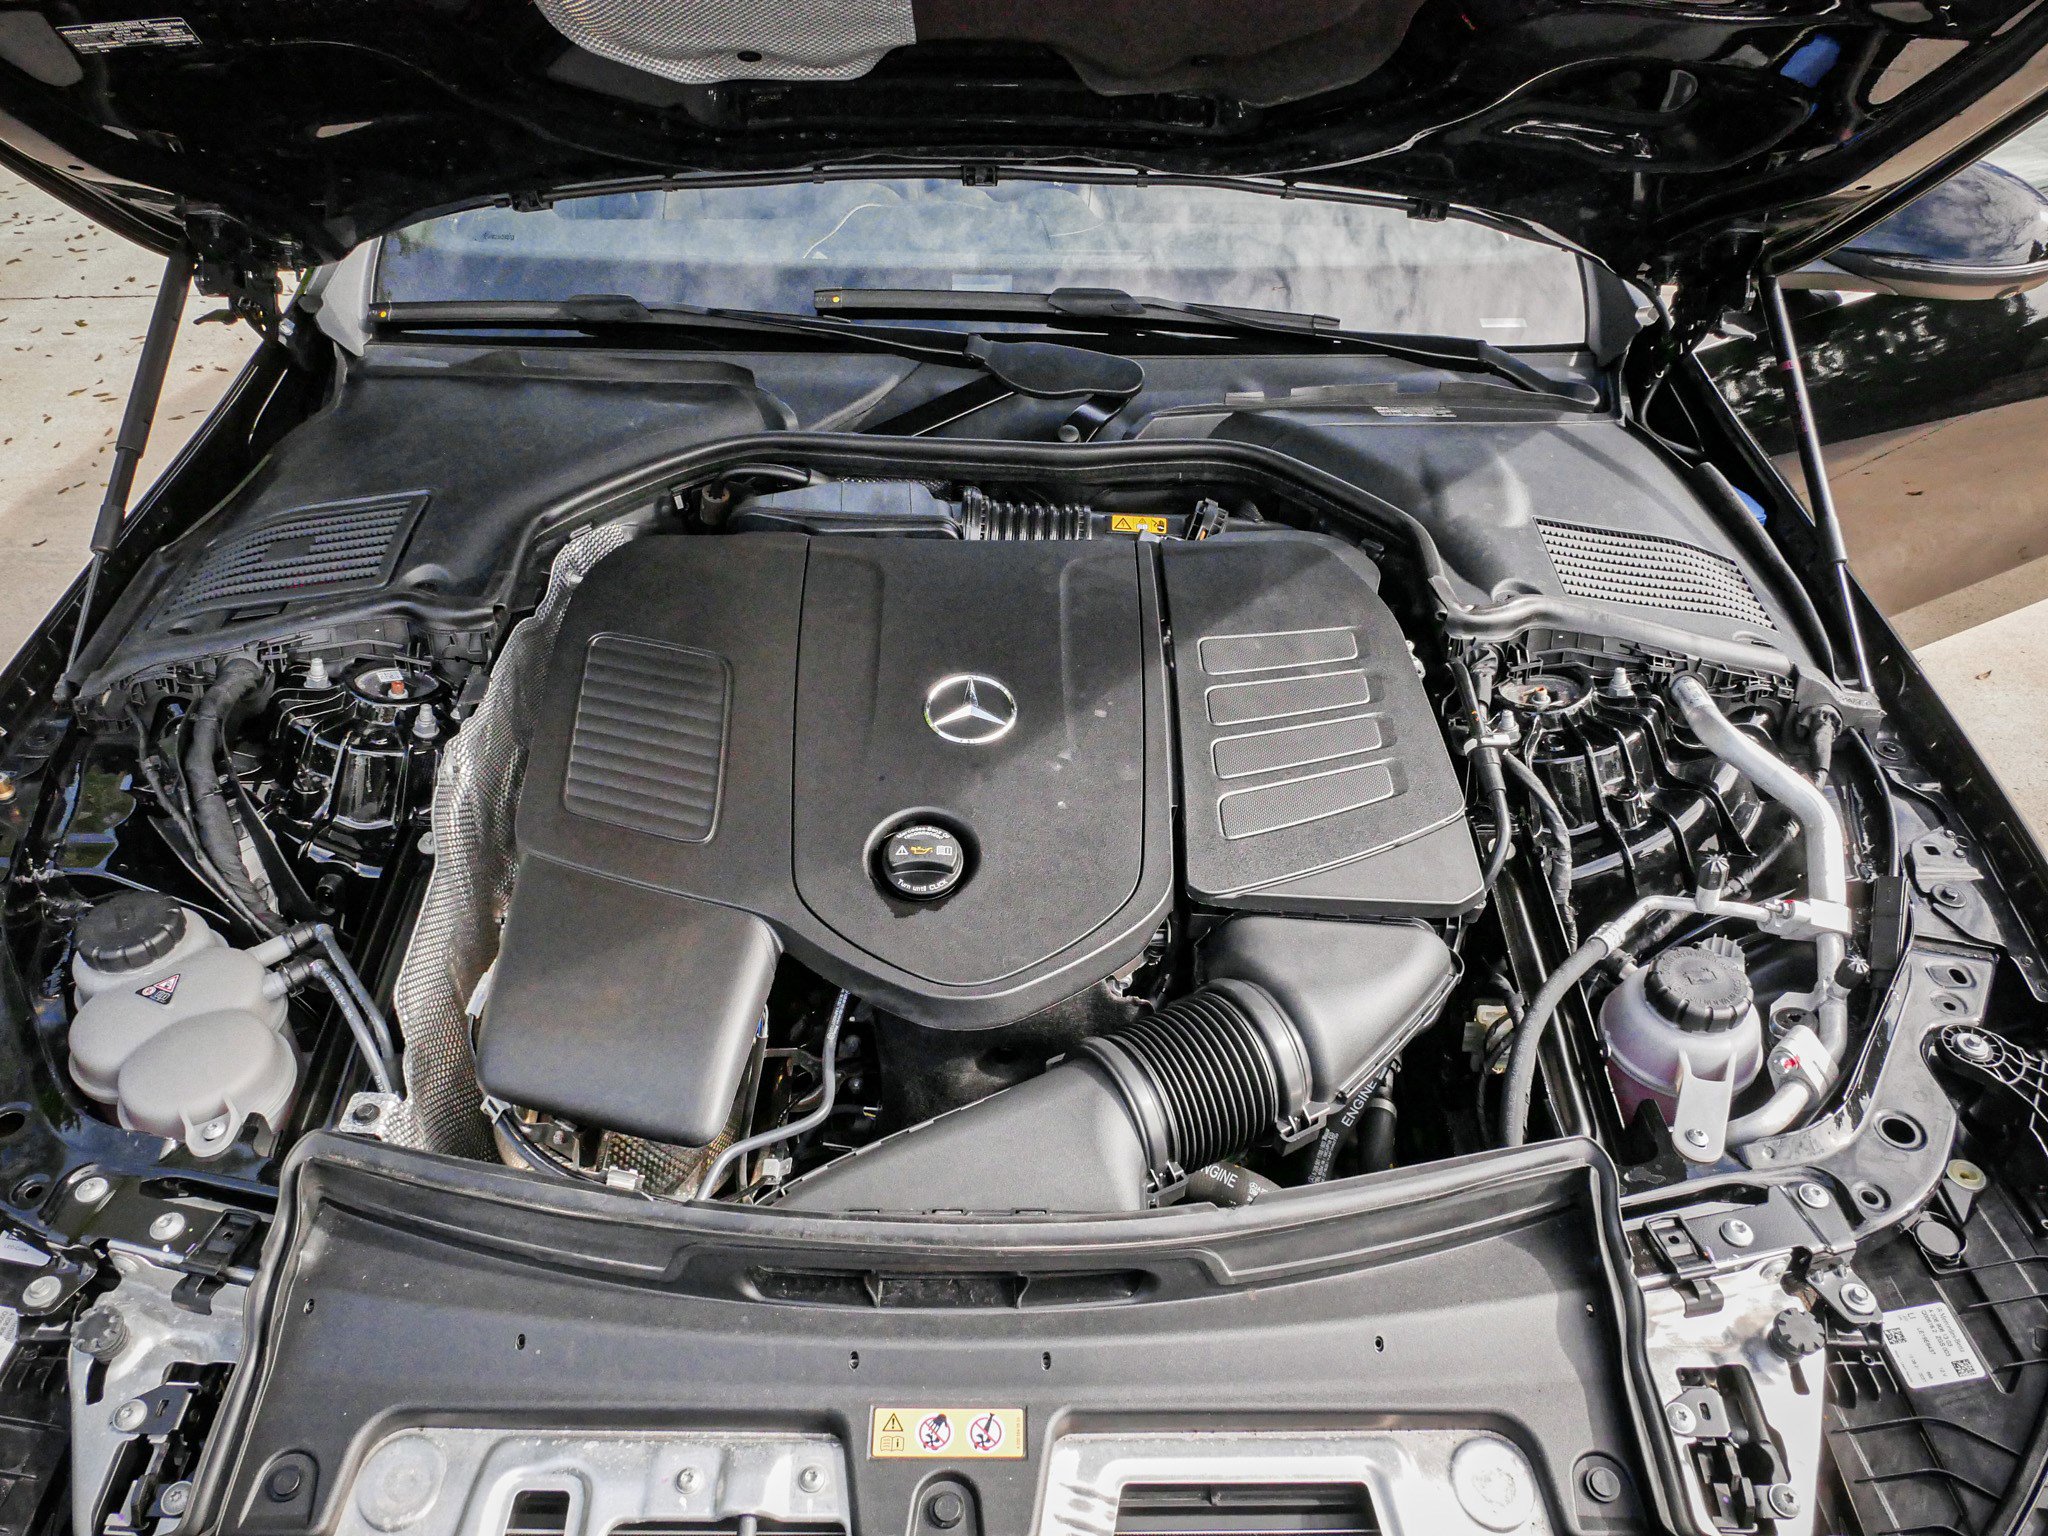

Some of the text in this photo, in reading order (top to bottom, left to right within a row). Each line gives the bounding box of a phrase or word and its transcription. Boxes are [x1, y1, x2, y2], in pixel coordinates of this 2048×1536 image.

[896, 826, 942, 839] Mercedes-Benz
[897, 878, 911, 890] Turn
[929, 879, 948, 890] CLICK
[1341, 1080, 1377, 1127] ENGINE
[1201, 1164, 1239, 1188] NGINE
